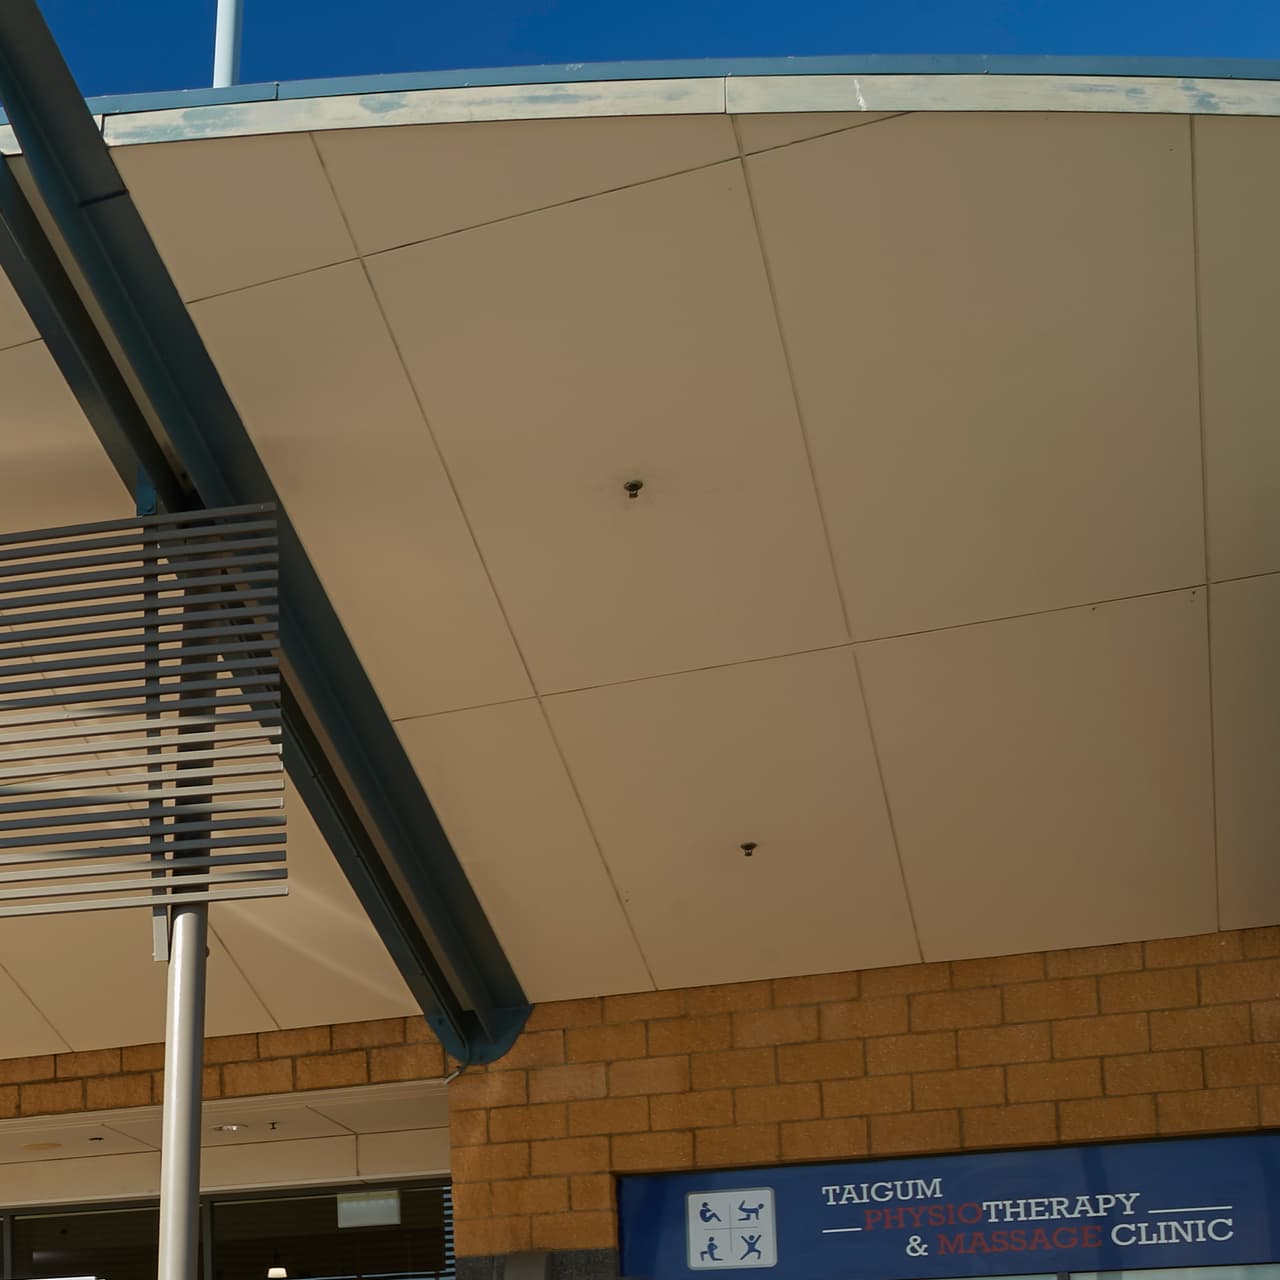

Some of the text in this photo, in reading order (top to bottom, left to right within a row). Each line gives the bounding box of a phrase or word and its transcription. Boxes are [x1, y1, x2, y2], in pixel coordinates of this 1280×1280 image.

[822, 1178, 942, 1205] TAIGUM
[864, 1192, 1141, 1231] PHYSIOTHERAPY
[905, 1218, 1234, 1257] & MASSAGE CLINIC
